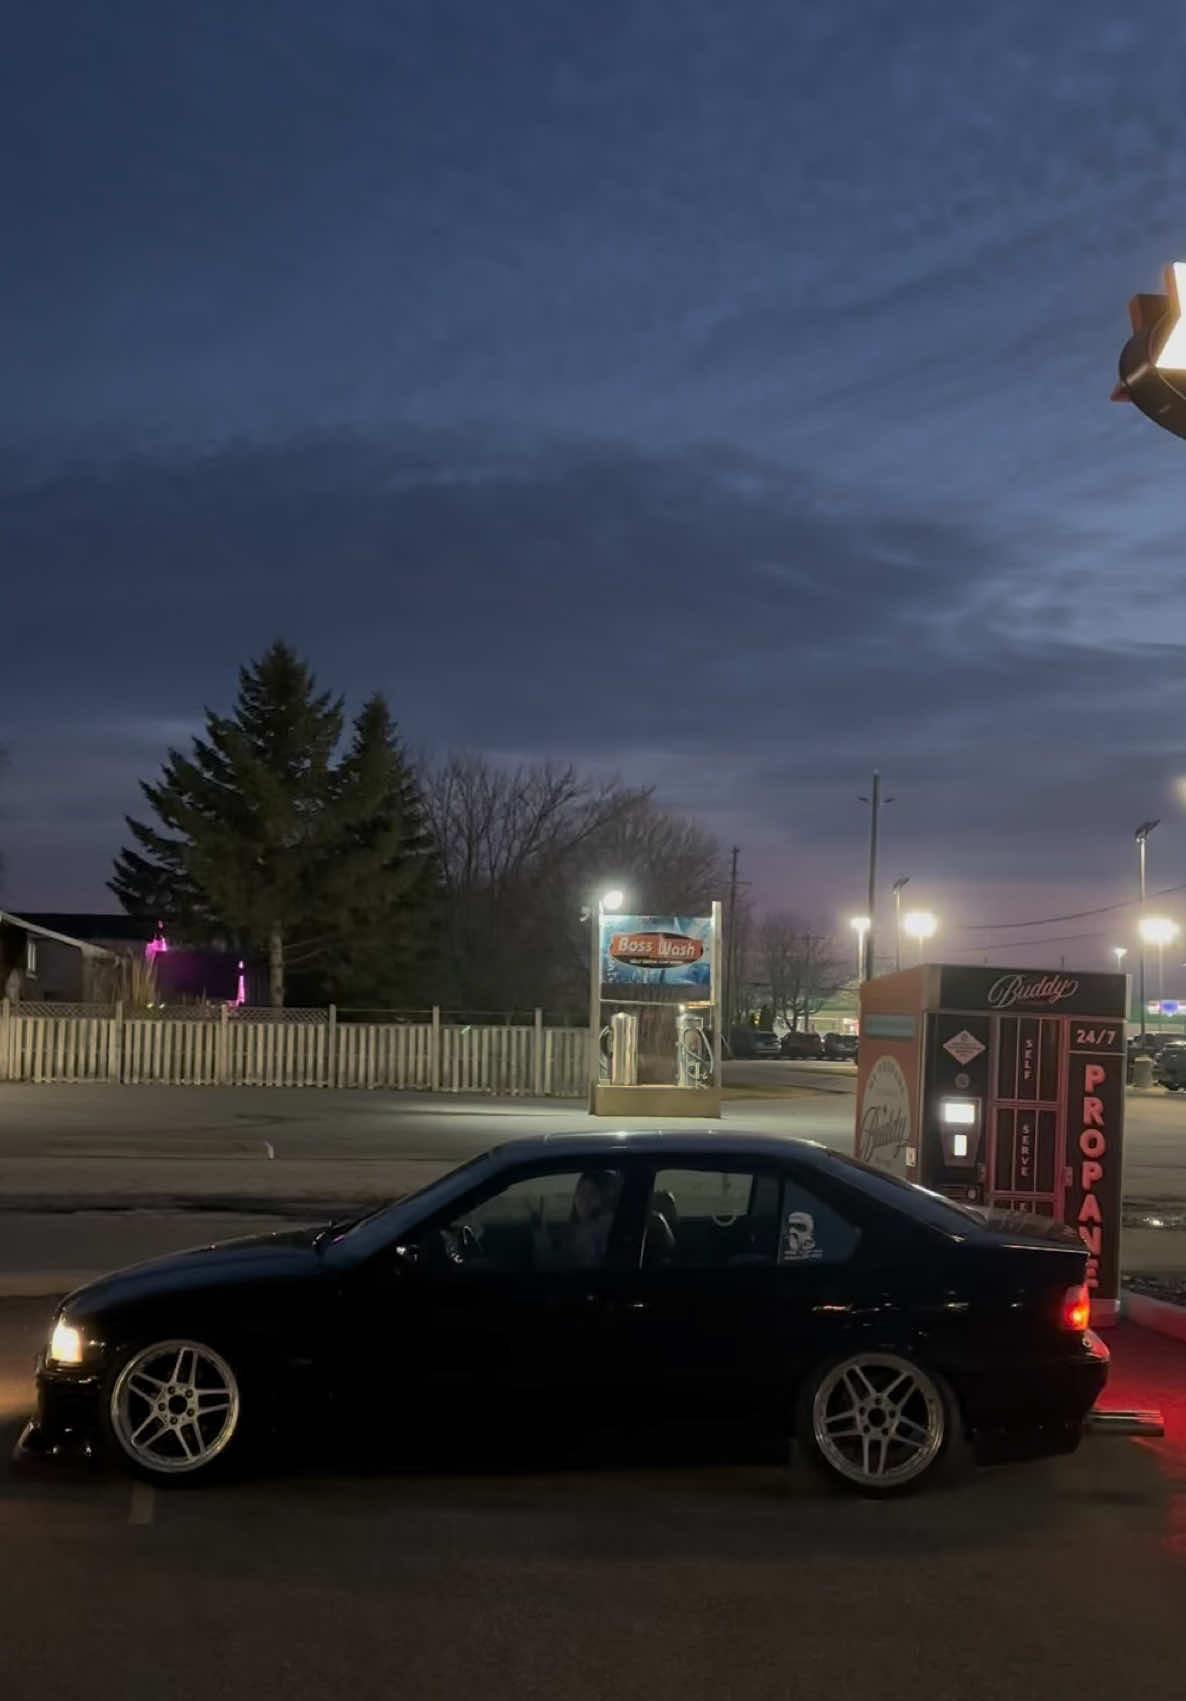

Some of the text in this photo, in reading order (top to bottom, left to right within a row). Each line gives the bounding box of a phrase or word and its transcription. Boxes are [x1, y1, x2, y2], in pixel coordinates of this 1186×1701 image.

[618, 937, 696, 957] Boss Wash
[988, 974, 1079, 1008] Buddy
[1077, 1029, 1116, 1045] 24/7
[1023, 1039, 1034, 1081] SELF
